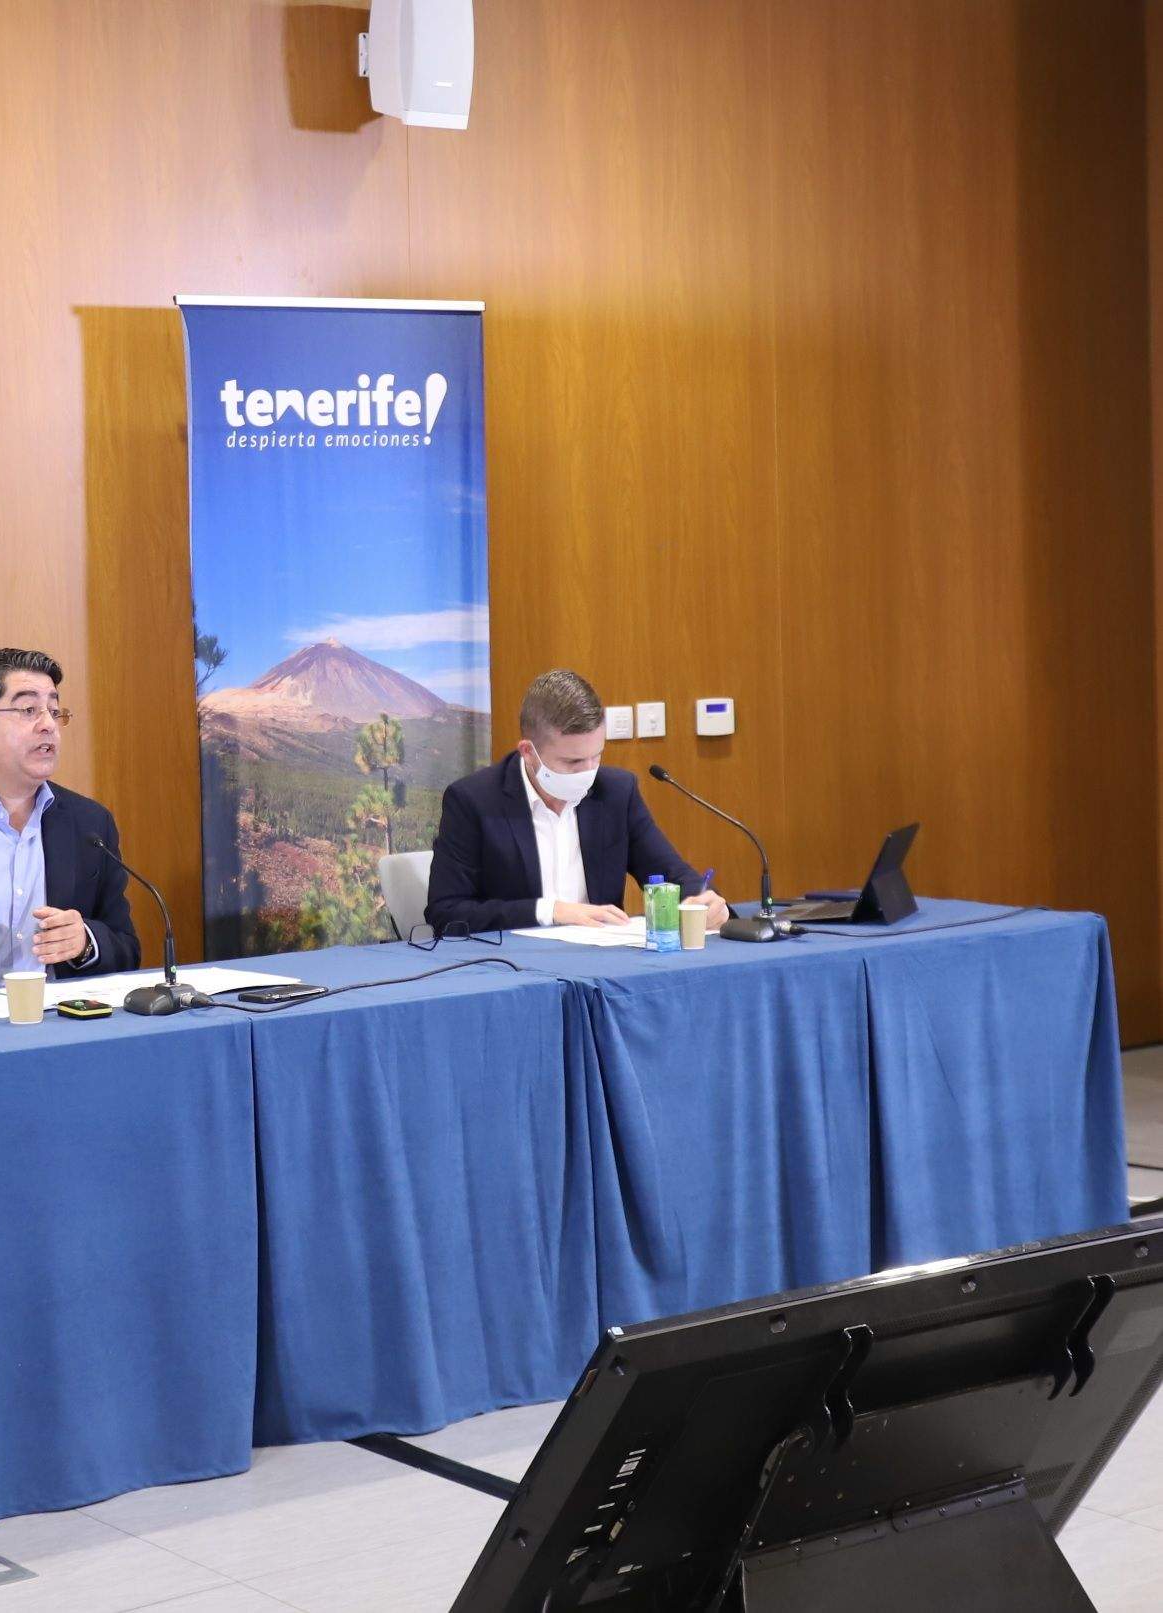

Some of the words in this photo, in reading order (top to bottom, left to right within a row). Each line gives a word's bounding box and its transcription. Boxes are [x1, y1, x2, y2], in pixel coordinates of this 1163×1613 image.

[220, 372, 448, 446] tenerife!
[226, 430, 317, 450] despierta
[325, 431, 420, 447] emociones
